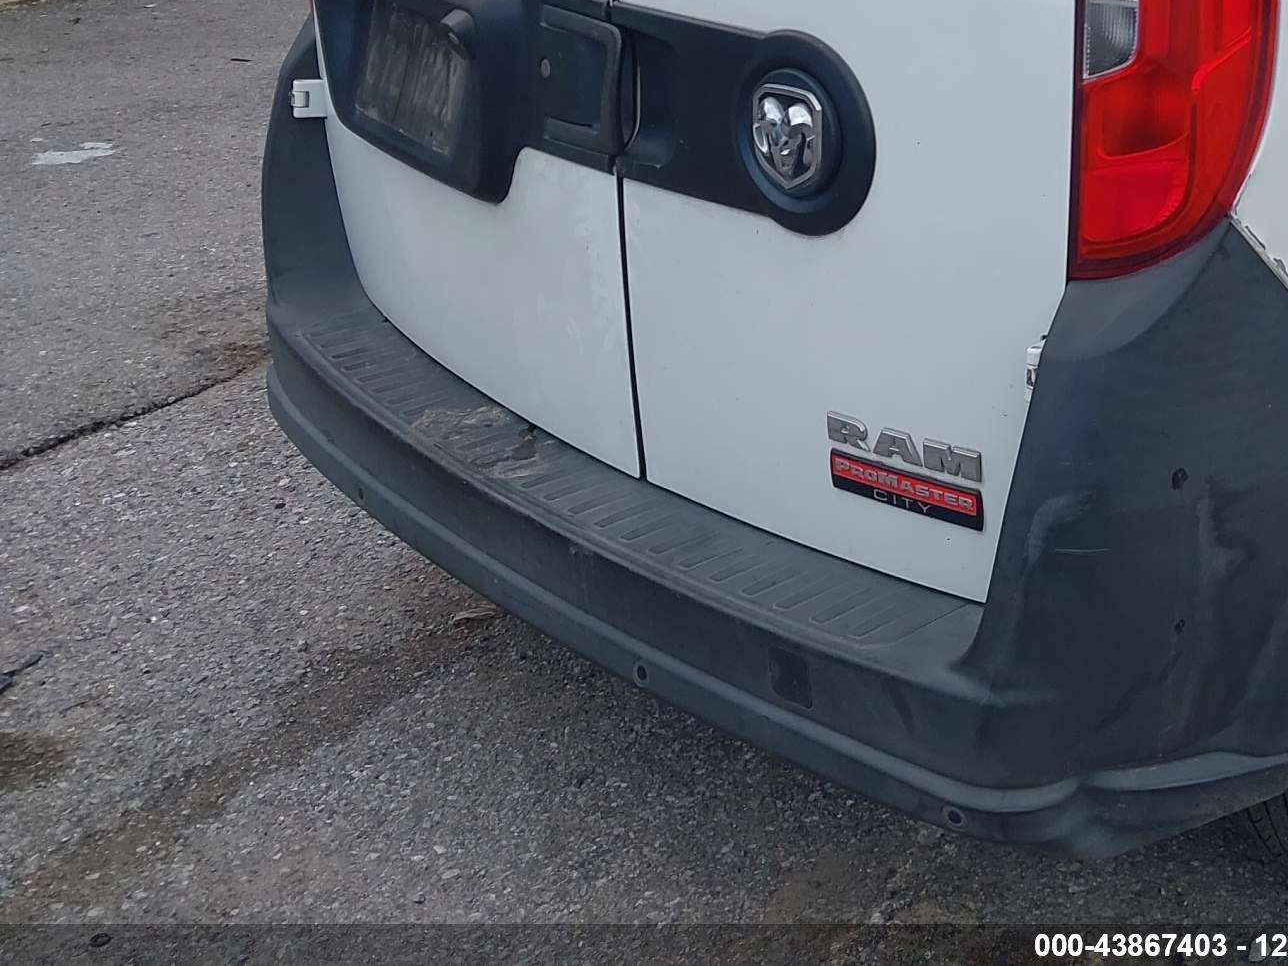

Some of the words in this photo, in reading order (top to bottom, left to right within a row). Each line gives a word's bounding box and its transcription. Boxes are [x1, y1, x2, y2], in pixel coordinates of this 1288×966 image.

[826, 410, 983, 483] RAM
[834, 457, 975, 511] PROMASTER
[873, 489, 932, 514] CITY
